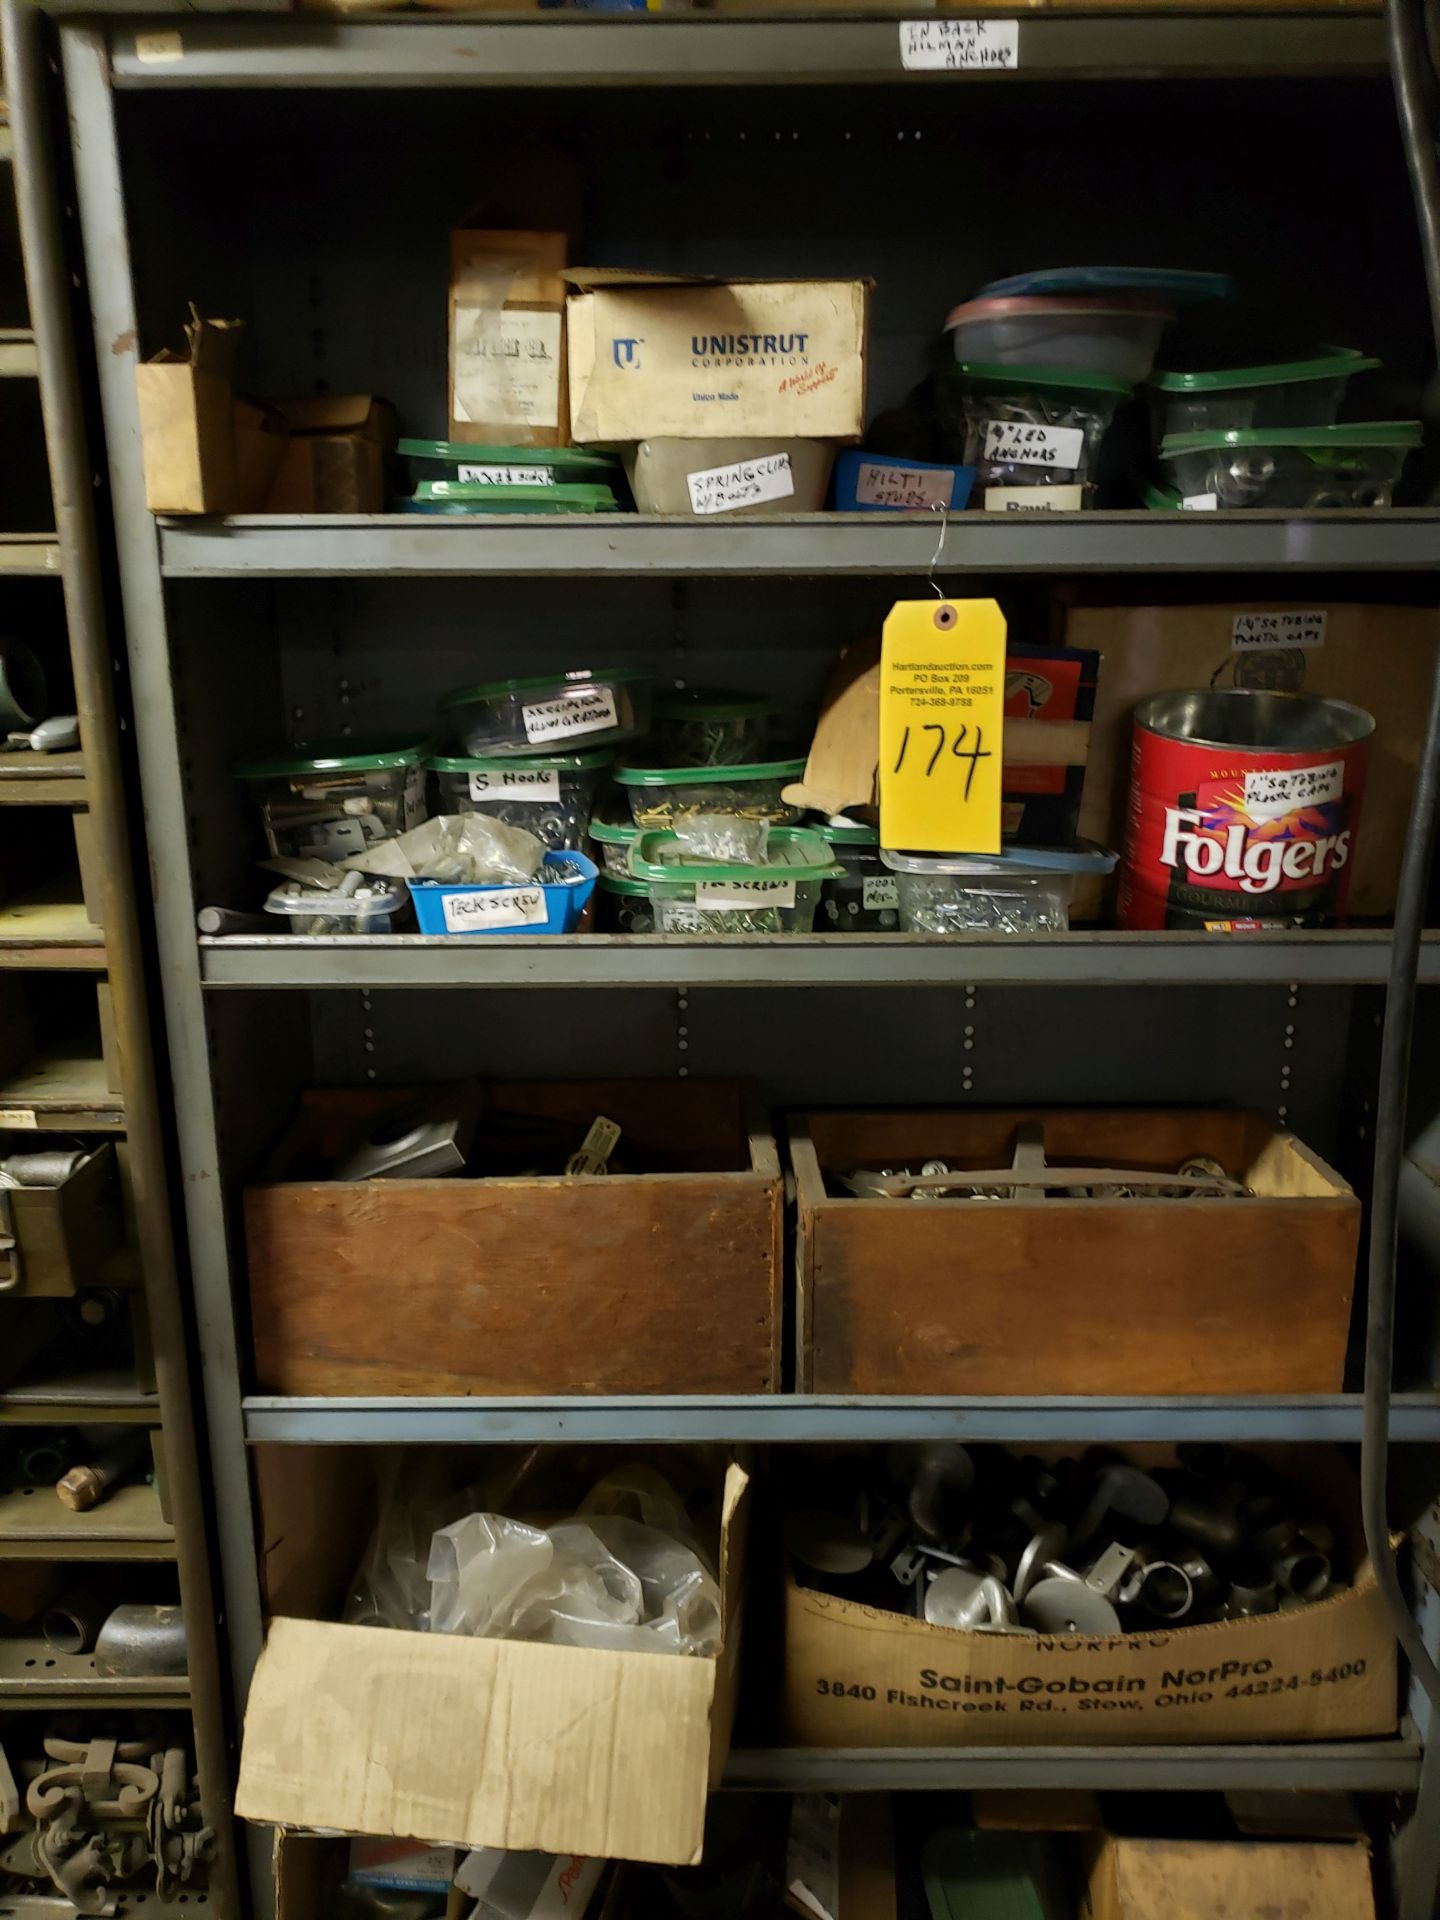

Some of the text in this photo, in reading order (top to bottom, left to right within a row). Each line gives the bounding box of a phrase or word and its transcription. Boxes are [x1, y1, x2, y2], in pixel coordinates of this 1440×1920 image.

[939, 19, 986, 37] BACK
[692, 333, 809, 355] UNISTRUT
[691, 355, 809, 368] CORPORATION
[693, 392, 739, 401] Union Made
[866, 468, 922, 489] HILTI
[892, 662, 993, 672] Hartlandauction.com
[913, 673, 970, 683] PO Box 209
[949, 685, 963, 695] PA
[966, 686, 994, 695] 16051
[893, 723, 993, 803] 174
[475, 773, 489, 791] S
[1159, 806, 1351, 894] Folgers
[919, 1658, 1273, 1694] Saint-Gobain NorPro
[816, 1658, 1368, 1713] 3840 Fishcreek Rd., Stow, Ohio 44224-5400
